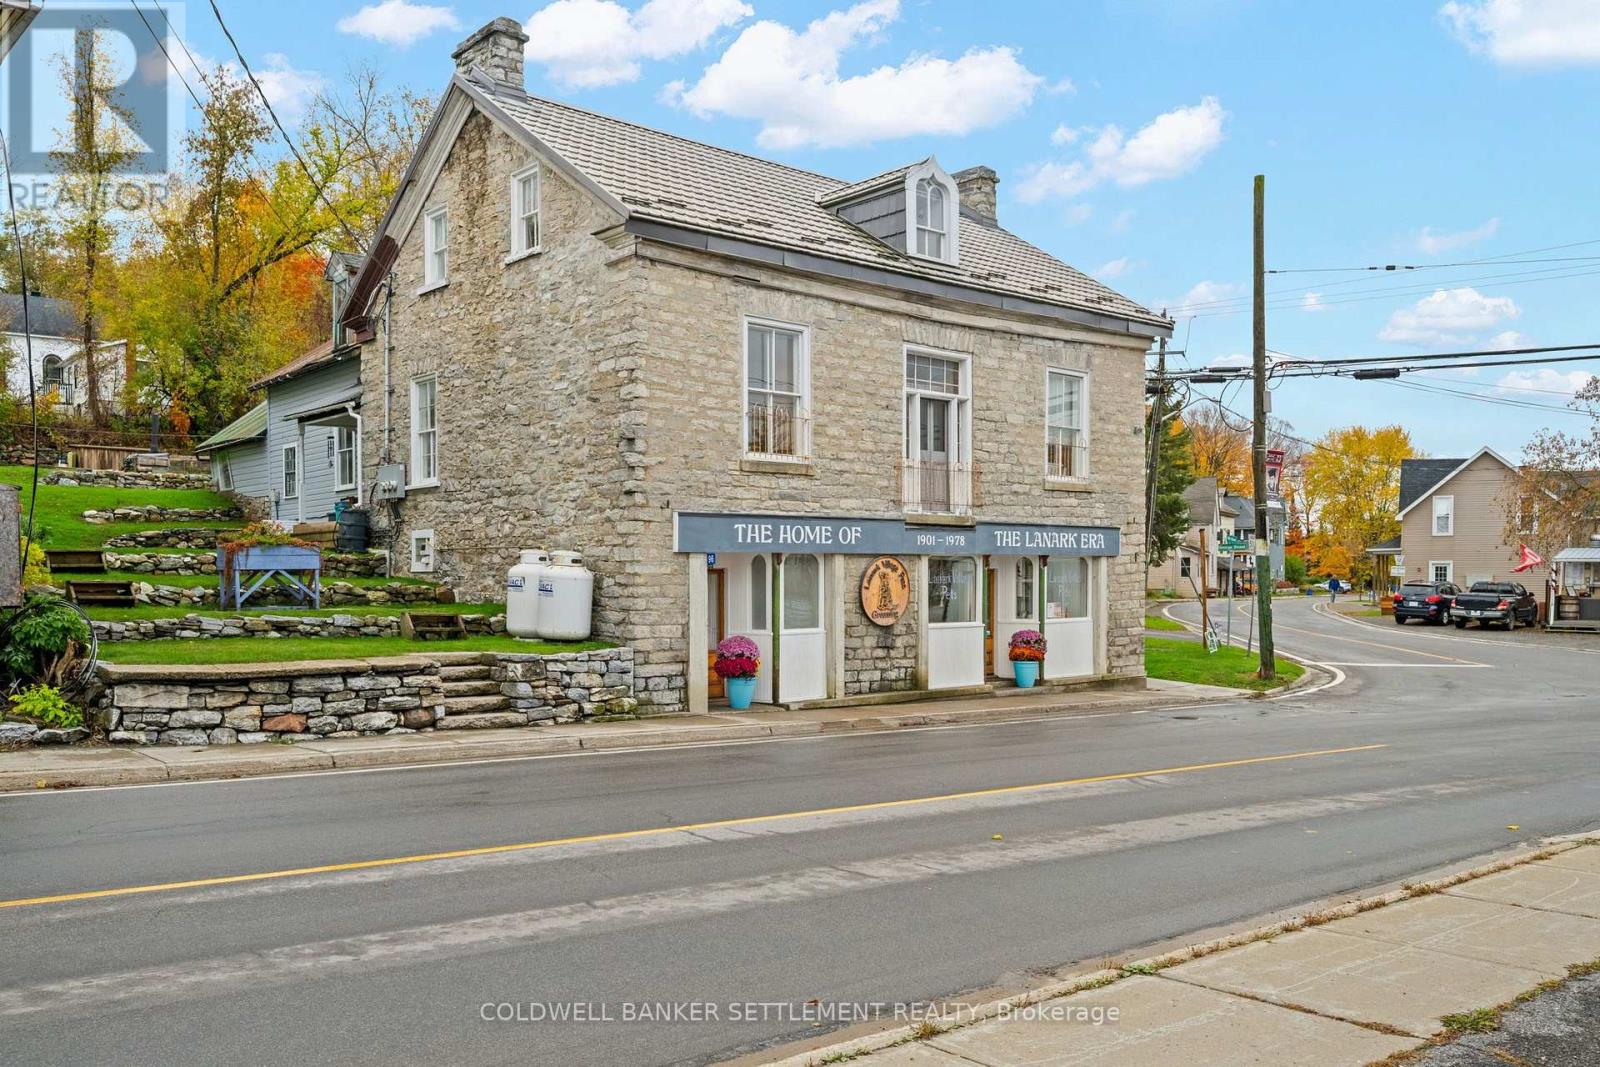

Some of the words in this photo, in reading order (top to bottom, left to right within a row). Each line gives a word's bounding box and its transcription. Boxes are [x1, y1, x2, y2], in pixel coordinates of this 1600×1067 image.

[734, 524, 773, 544] THE
[779, 525, 833, 545] HOME
[839, 526, 862, 545] OF
[917, 534, 936, 546] 1901
[945, 535, 966, 547] 1978
[994, 530, 1021, 548] THE
[1025, 532, 1078, 549] LANARK
[1080, 533, 1105, 550] ERA
